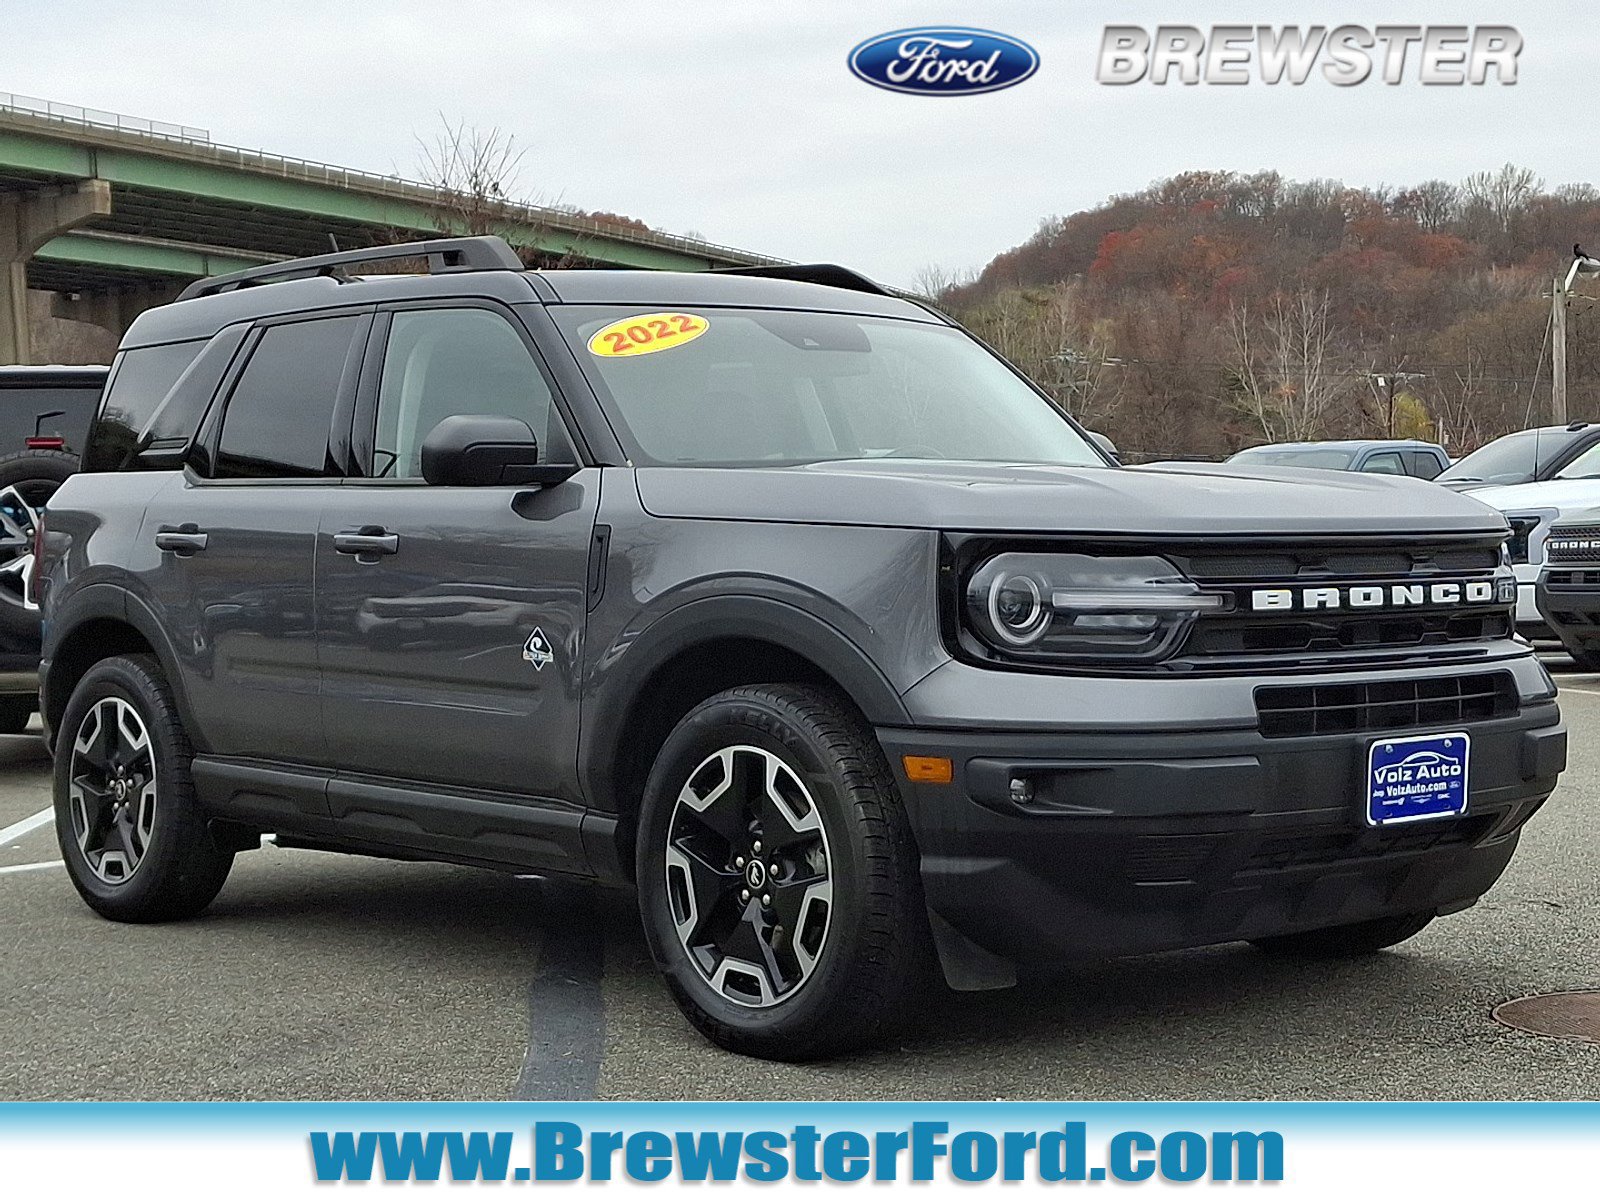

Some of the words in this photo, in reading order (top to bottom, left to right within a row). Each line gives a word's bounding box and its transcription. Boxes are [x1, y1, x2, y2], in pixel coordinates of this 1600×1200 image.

[603, 315, 700, 352] 2022
[1252, 582, 1492, 611] BRONCO
[1374, 766, 1412, 784] Volz
[1416, 763, 1462, 780] Auto
[1386, 781, 1447, 796] VolzAuto.com
